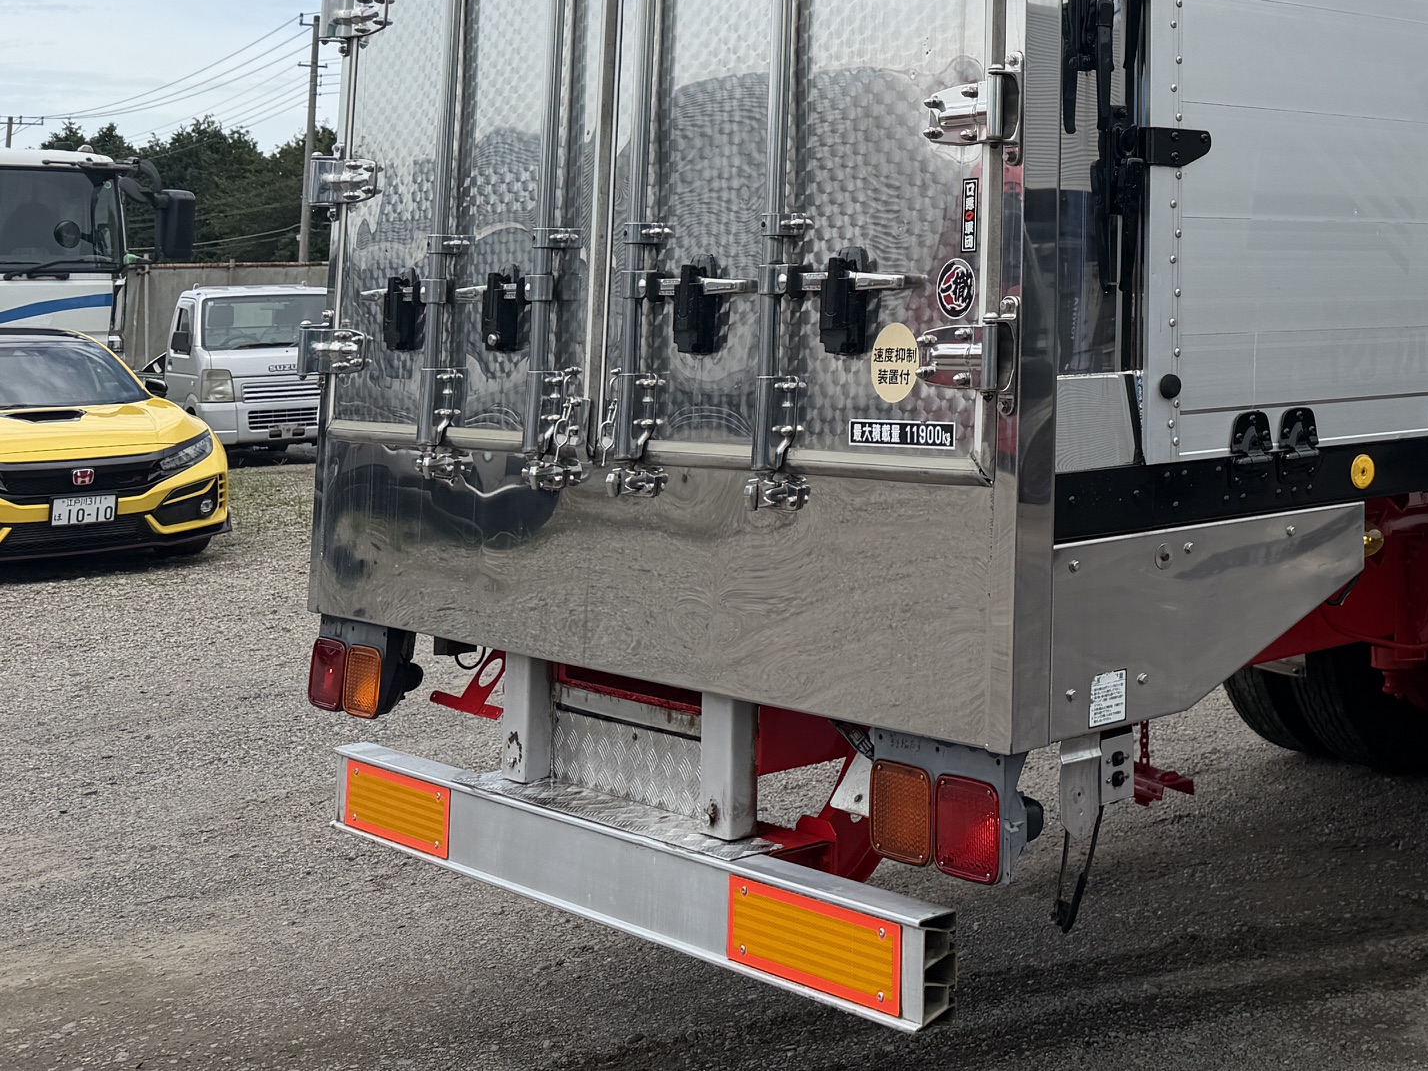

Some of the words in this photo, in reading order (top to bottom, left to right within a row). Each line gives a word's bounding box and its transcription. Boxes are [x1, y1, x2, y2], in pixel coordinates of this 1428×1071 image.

[873, 347, 917, 364] 速度抑制
[268, 363, 297, 372] SUZU
[877, 369, 911, 385] 装置付
[853, 423, 901, 443] 最大積載量
[67, 505, 114, 524] 10-10
